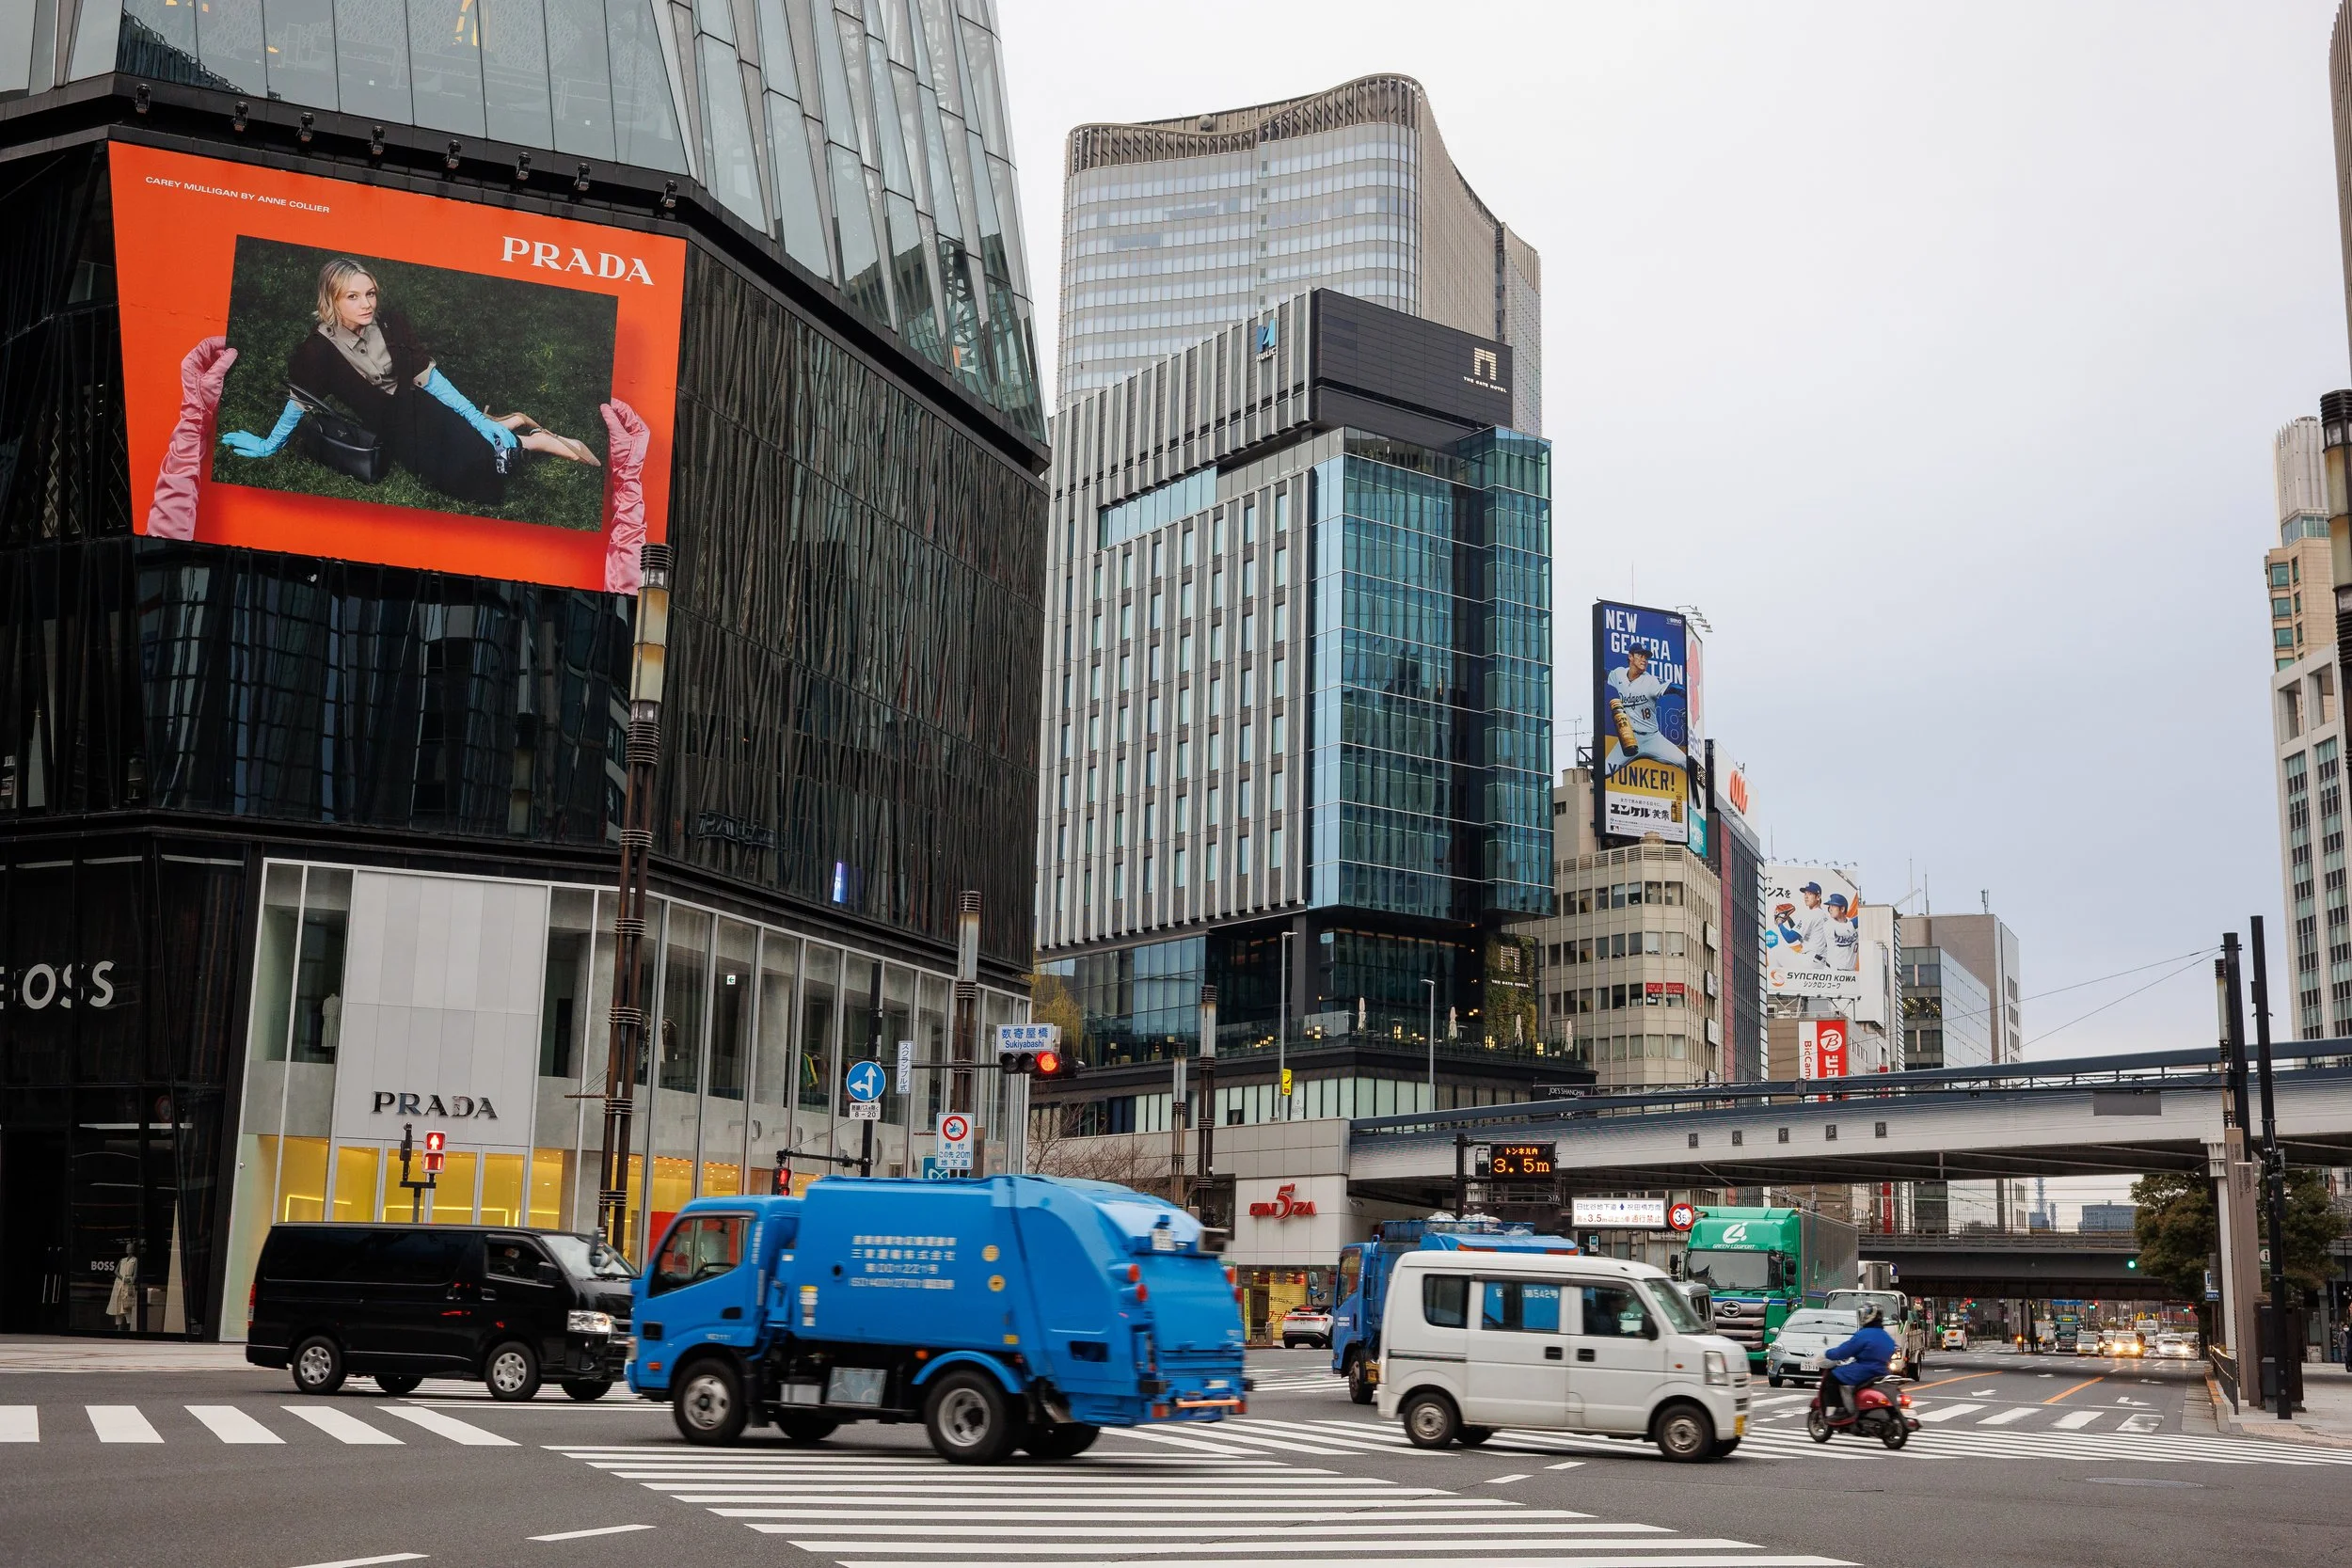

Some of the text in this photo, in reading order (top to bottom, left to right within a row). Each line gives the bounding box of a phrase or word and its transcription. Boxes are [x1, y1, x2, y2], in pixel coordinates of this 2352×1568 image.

[146, 176, 330, 214] CAREY MULLIGAN BY ANNE COLLIER
[501, 236, 655, 286] PRADA
[1256, 347, 1278, 362] HULIC
[1490, 385, 1507, 393] HOTEL
[1605, 609, 1638, 633] NEW
[1648, 660, 1683, 685] TION
[1641, 707, 1651, 720] 18
[1608, 763, 1675, 791] YUNKER!
[1765, 887, 1791, 898] ンスを
[0, 960, 115, 1010] OSS
[1787, 972, 1833, 982] SYNCRON
[1002, 1027, 1048, 1038] 数寄屋橋
[1005, 1039, 1044, 1049] Sukiyabashi
[899, 1044, 909, 1091] スクランブル式
[373, 1091, 498, 1119] PRADA
[90, 1260, 115, 1271] BOSS
